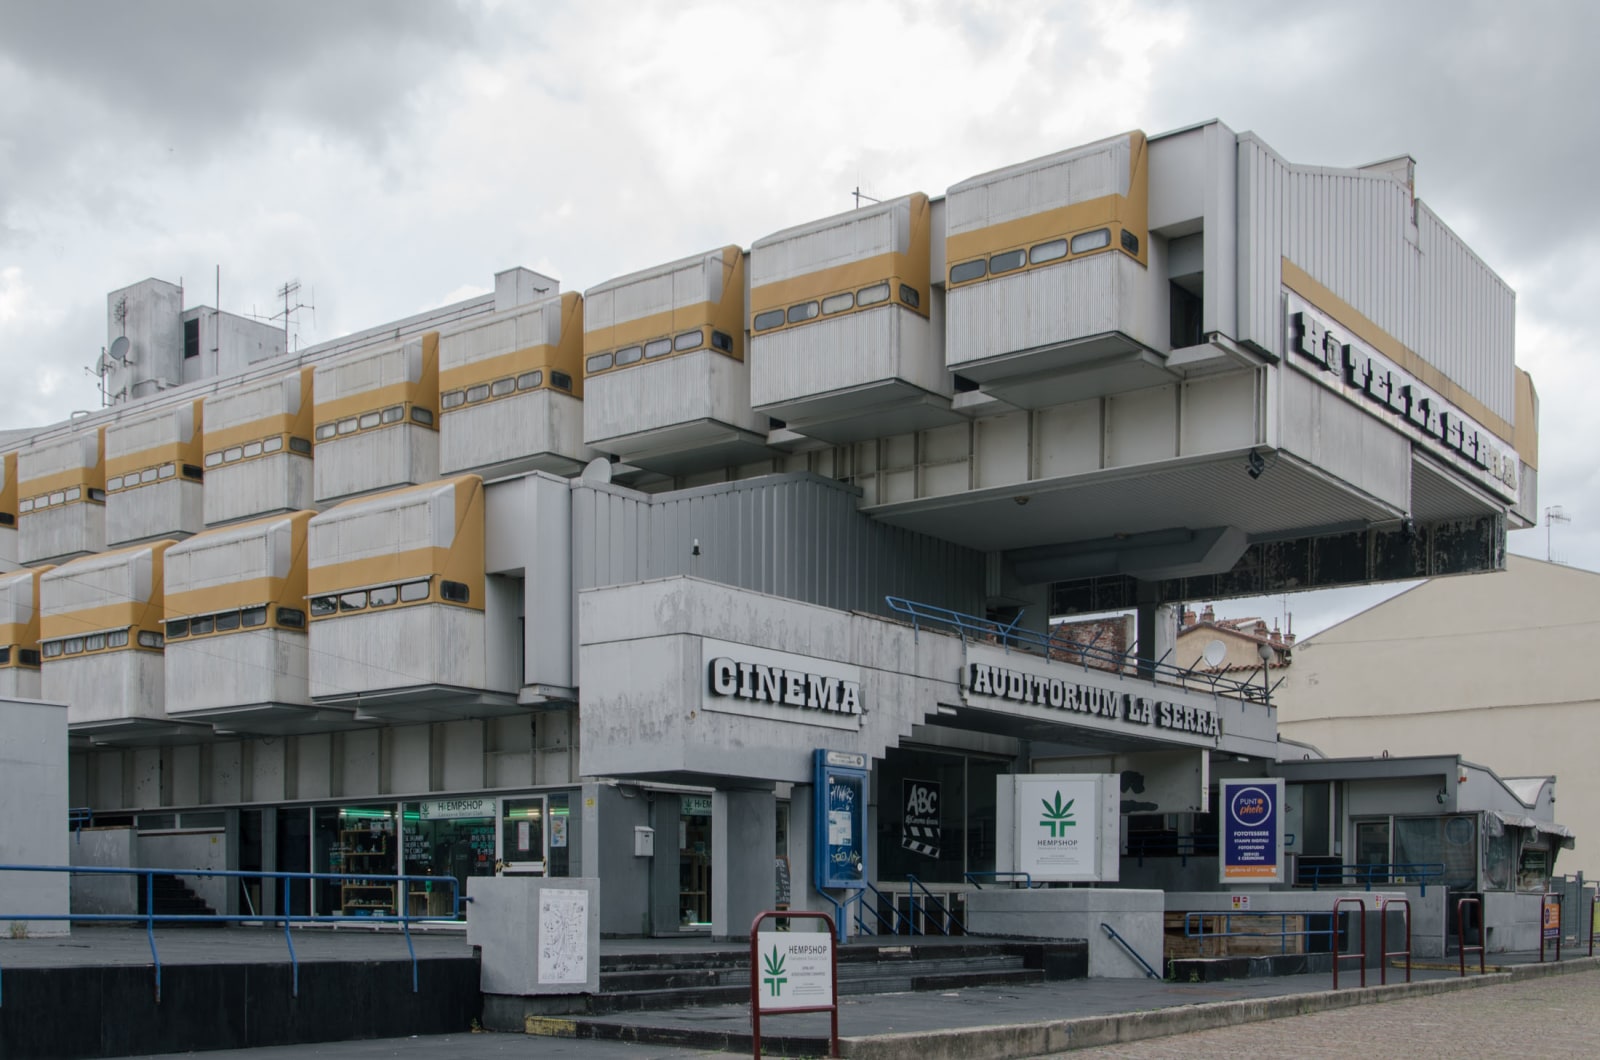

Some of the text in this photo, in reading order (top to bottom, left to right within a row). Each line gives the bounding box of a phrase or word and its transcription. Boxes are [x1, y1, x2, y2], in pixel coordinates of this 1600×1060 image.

[1292, 312, 1517, 491] HOTEL LA SERRA
[709, 657, 862, 715] CINEMA
[971, 663, 1220, 737] AUDITORIUM LA SERRA
[438, 800, 483, 811] HEMPSHOP
[907, 784, 937, 816] ABC
[789, 945, 828, 954] HEMPSHOP
